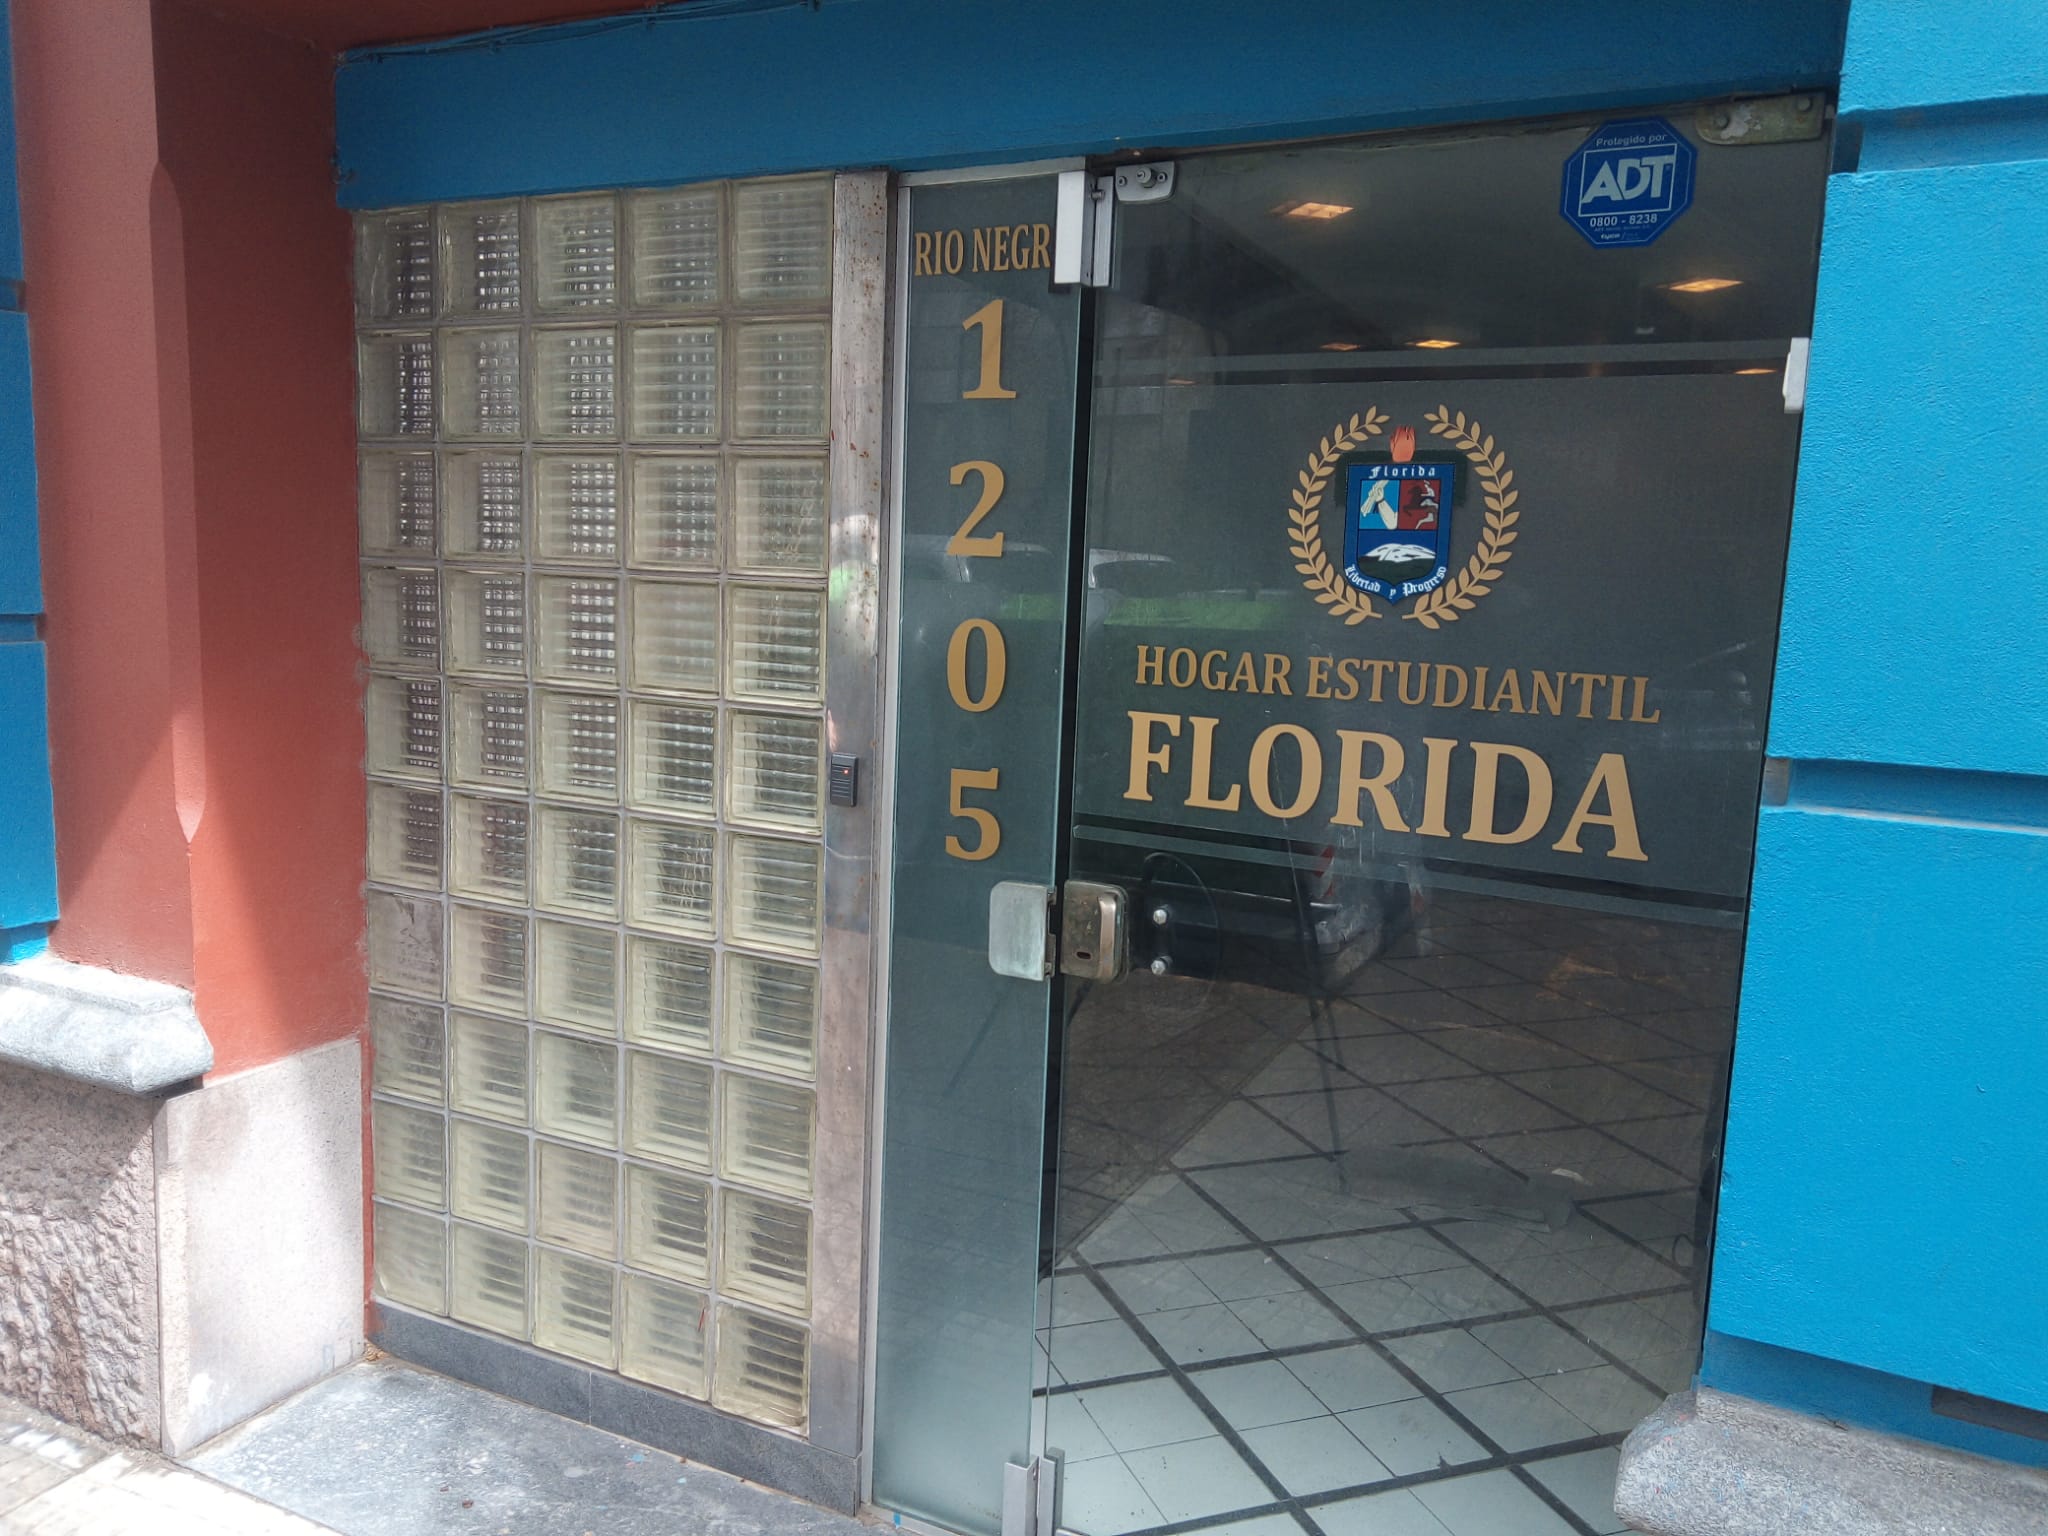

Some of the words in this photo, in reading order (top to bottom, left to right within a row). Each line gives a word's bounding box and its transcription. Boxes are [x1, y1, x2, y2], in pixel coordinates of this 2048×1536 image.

[1596, 135, 1646, 147] Protegido
[1649, 134, 1666, 144] por
[1581, 155, 1675, 204] ADT
[1590, 216, 1618, 227] 0800
[1629, 213, 1658, 225] 8238
[914, 229, 964, 276] RIO
[972, 223, 1052, 273] NEGR
[1369, 465, 1436, 479] Florida
[1135, 645, 1293, 696] HOGAR
[1306, 656, 1662, 724] ESTUDIANTIL
[1123, 710, 1649, 863] FLORIDA
